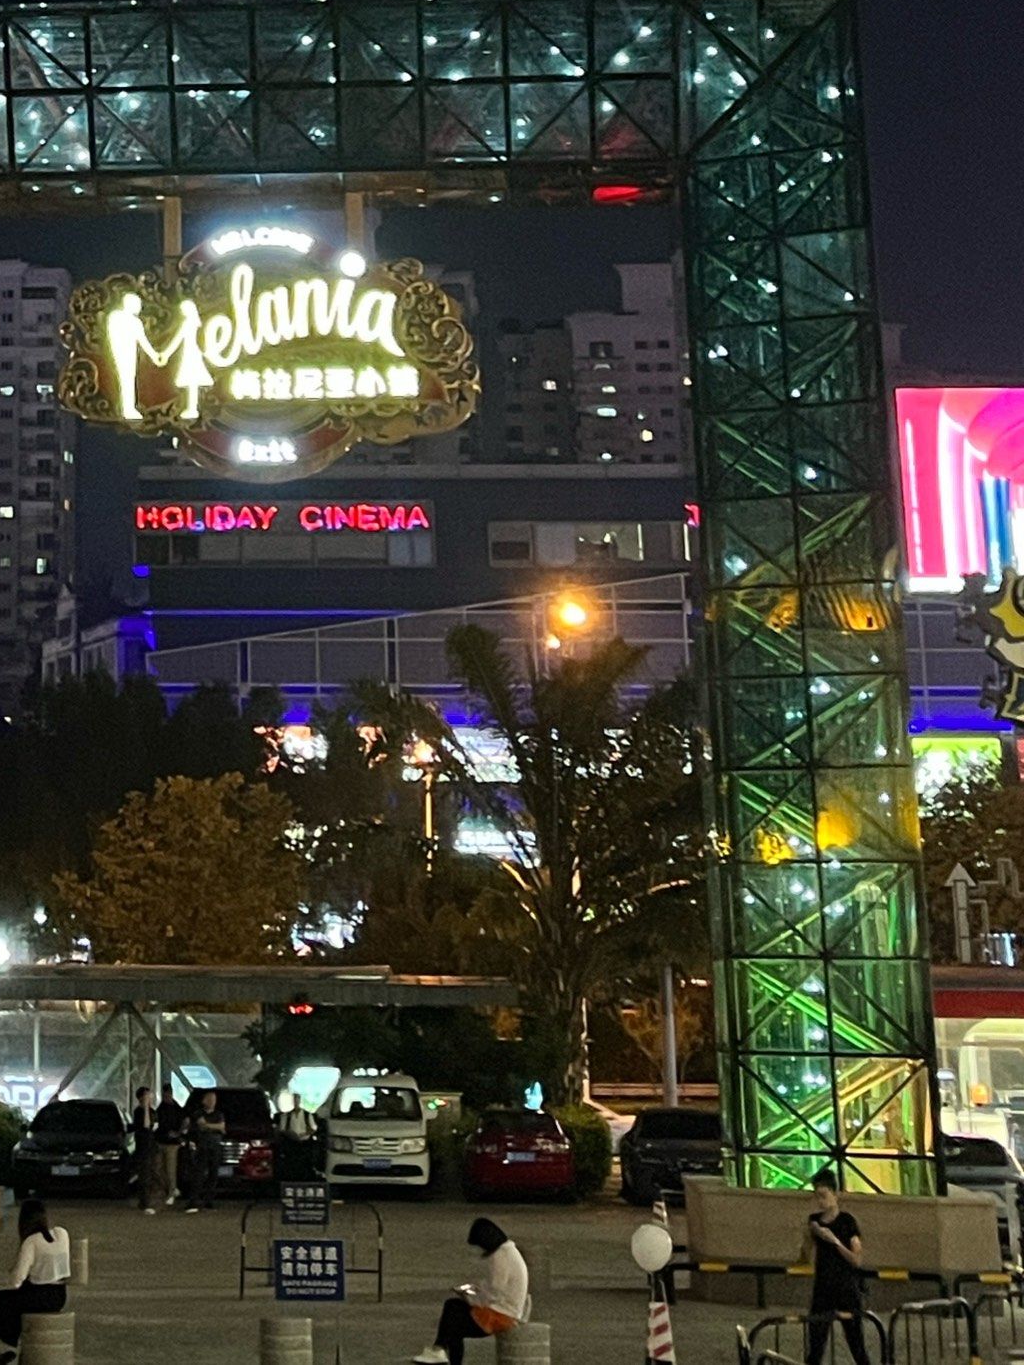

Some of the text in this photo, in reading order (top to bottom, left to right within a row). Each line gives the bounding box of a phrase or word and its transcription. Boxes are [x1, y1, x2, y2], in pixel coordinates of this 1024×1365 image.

[106, 252, 407, 421] Melania
[136, 503, 430, 533] HOLIDAY CINEMA
[280, 1245, 338, 1261] 安全通道
[281, 1262, 338, 1277] 请勿停车
